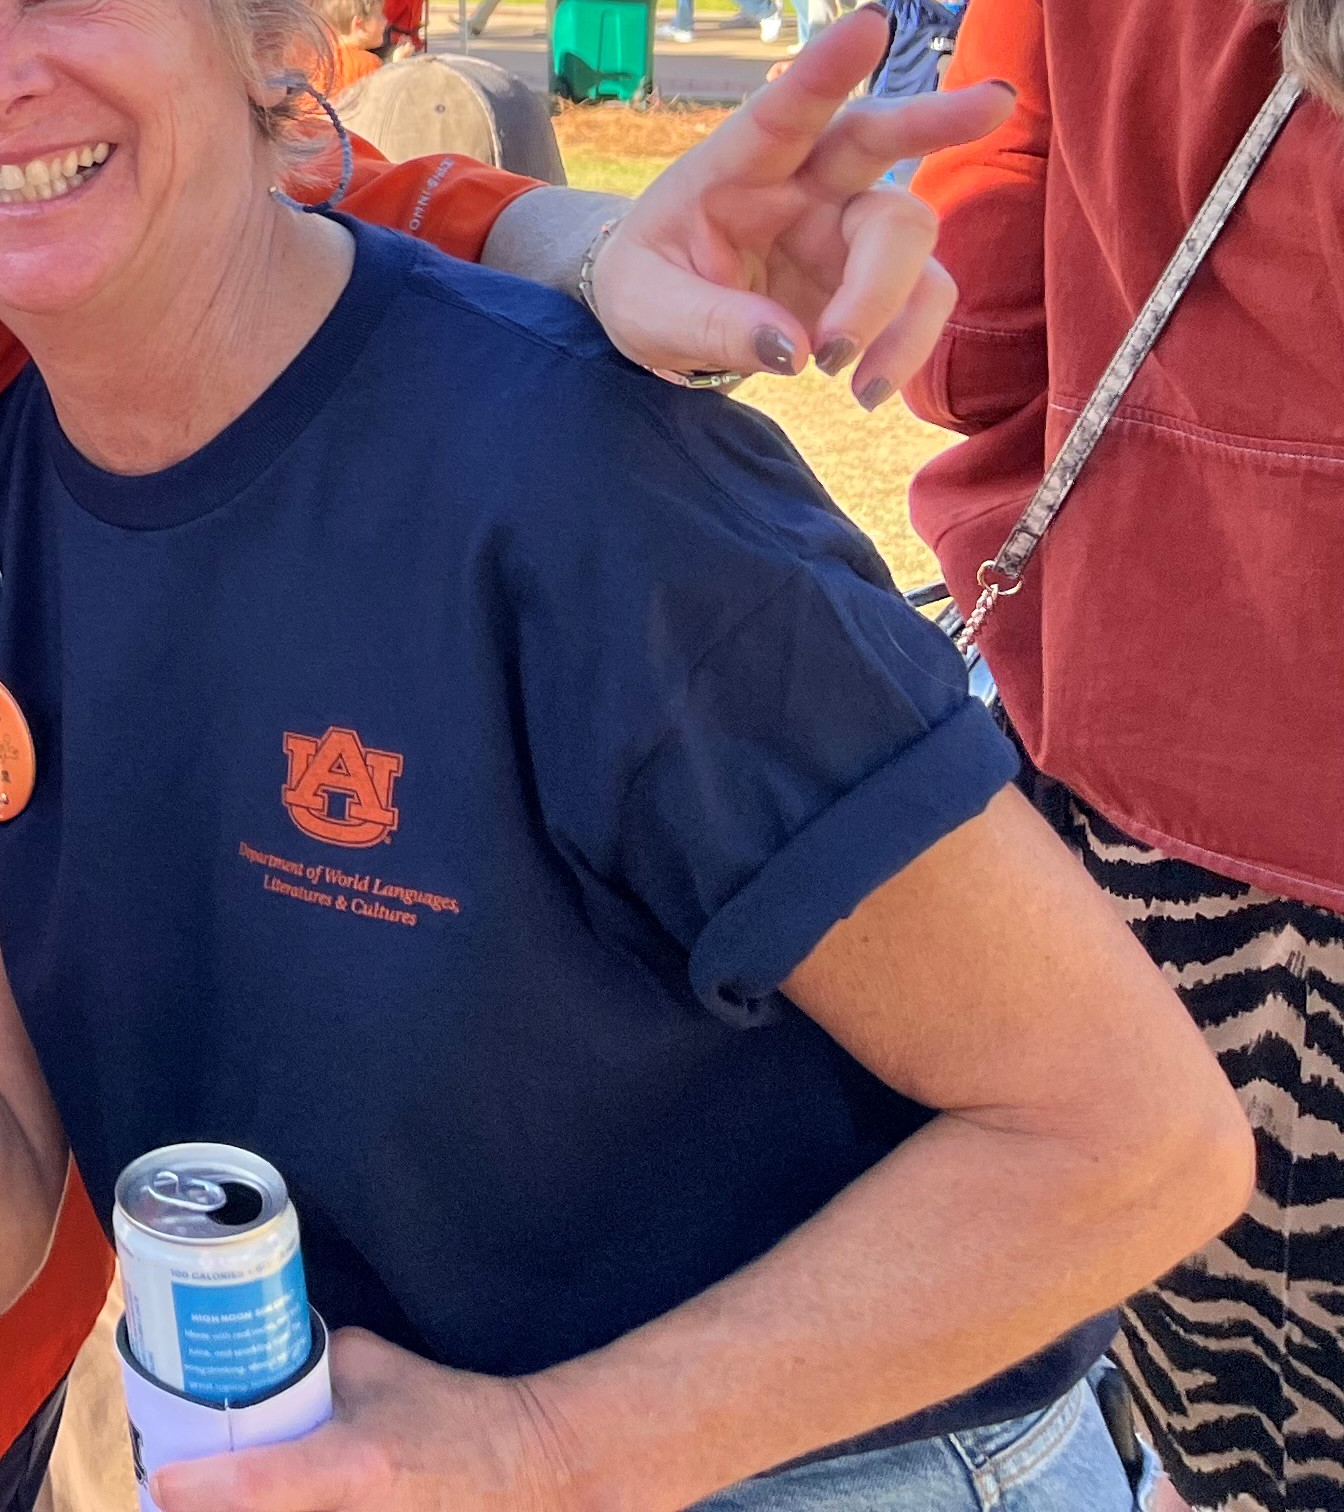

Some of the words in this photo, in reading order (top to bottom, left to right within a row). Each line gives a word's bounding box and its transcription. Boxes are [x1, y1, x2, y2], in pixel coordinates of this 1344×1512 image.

[306, 865, 325, 884] of
[324, 866, 370, 894] World
[334, 894, 349, 912] &
[349, 896, 419, 927] Cultures
